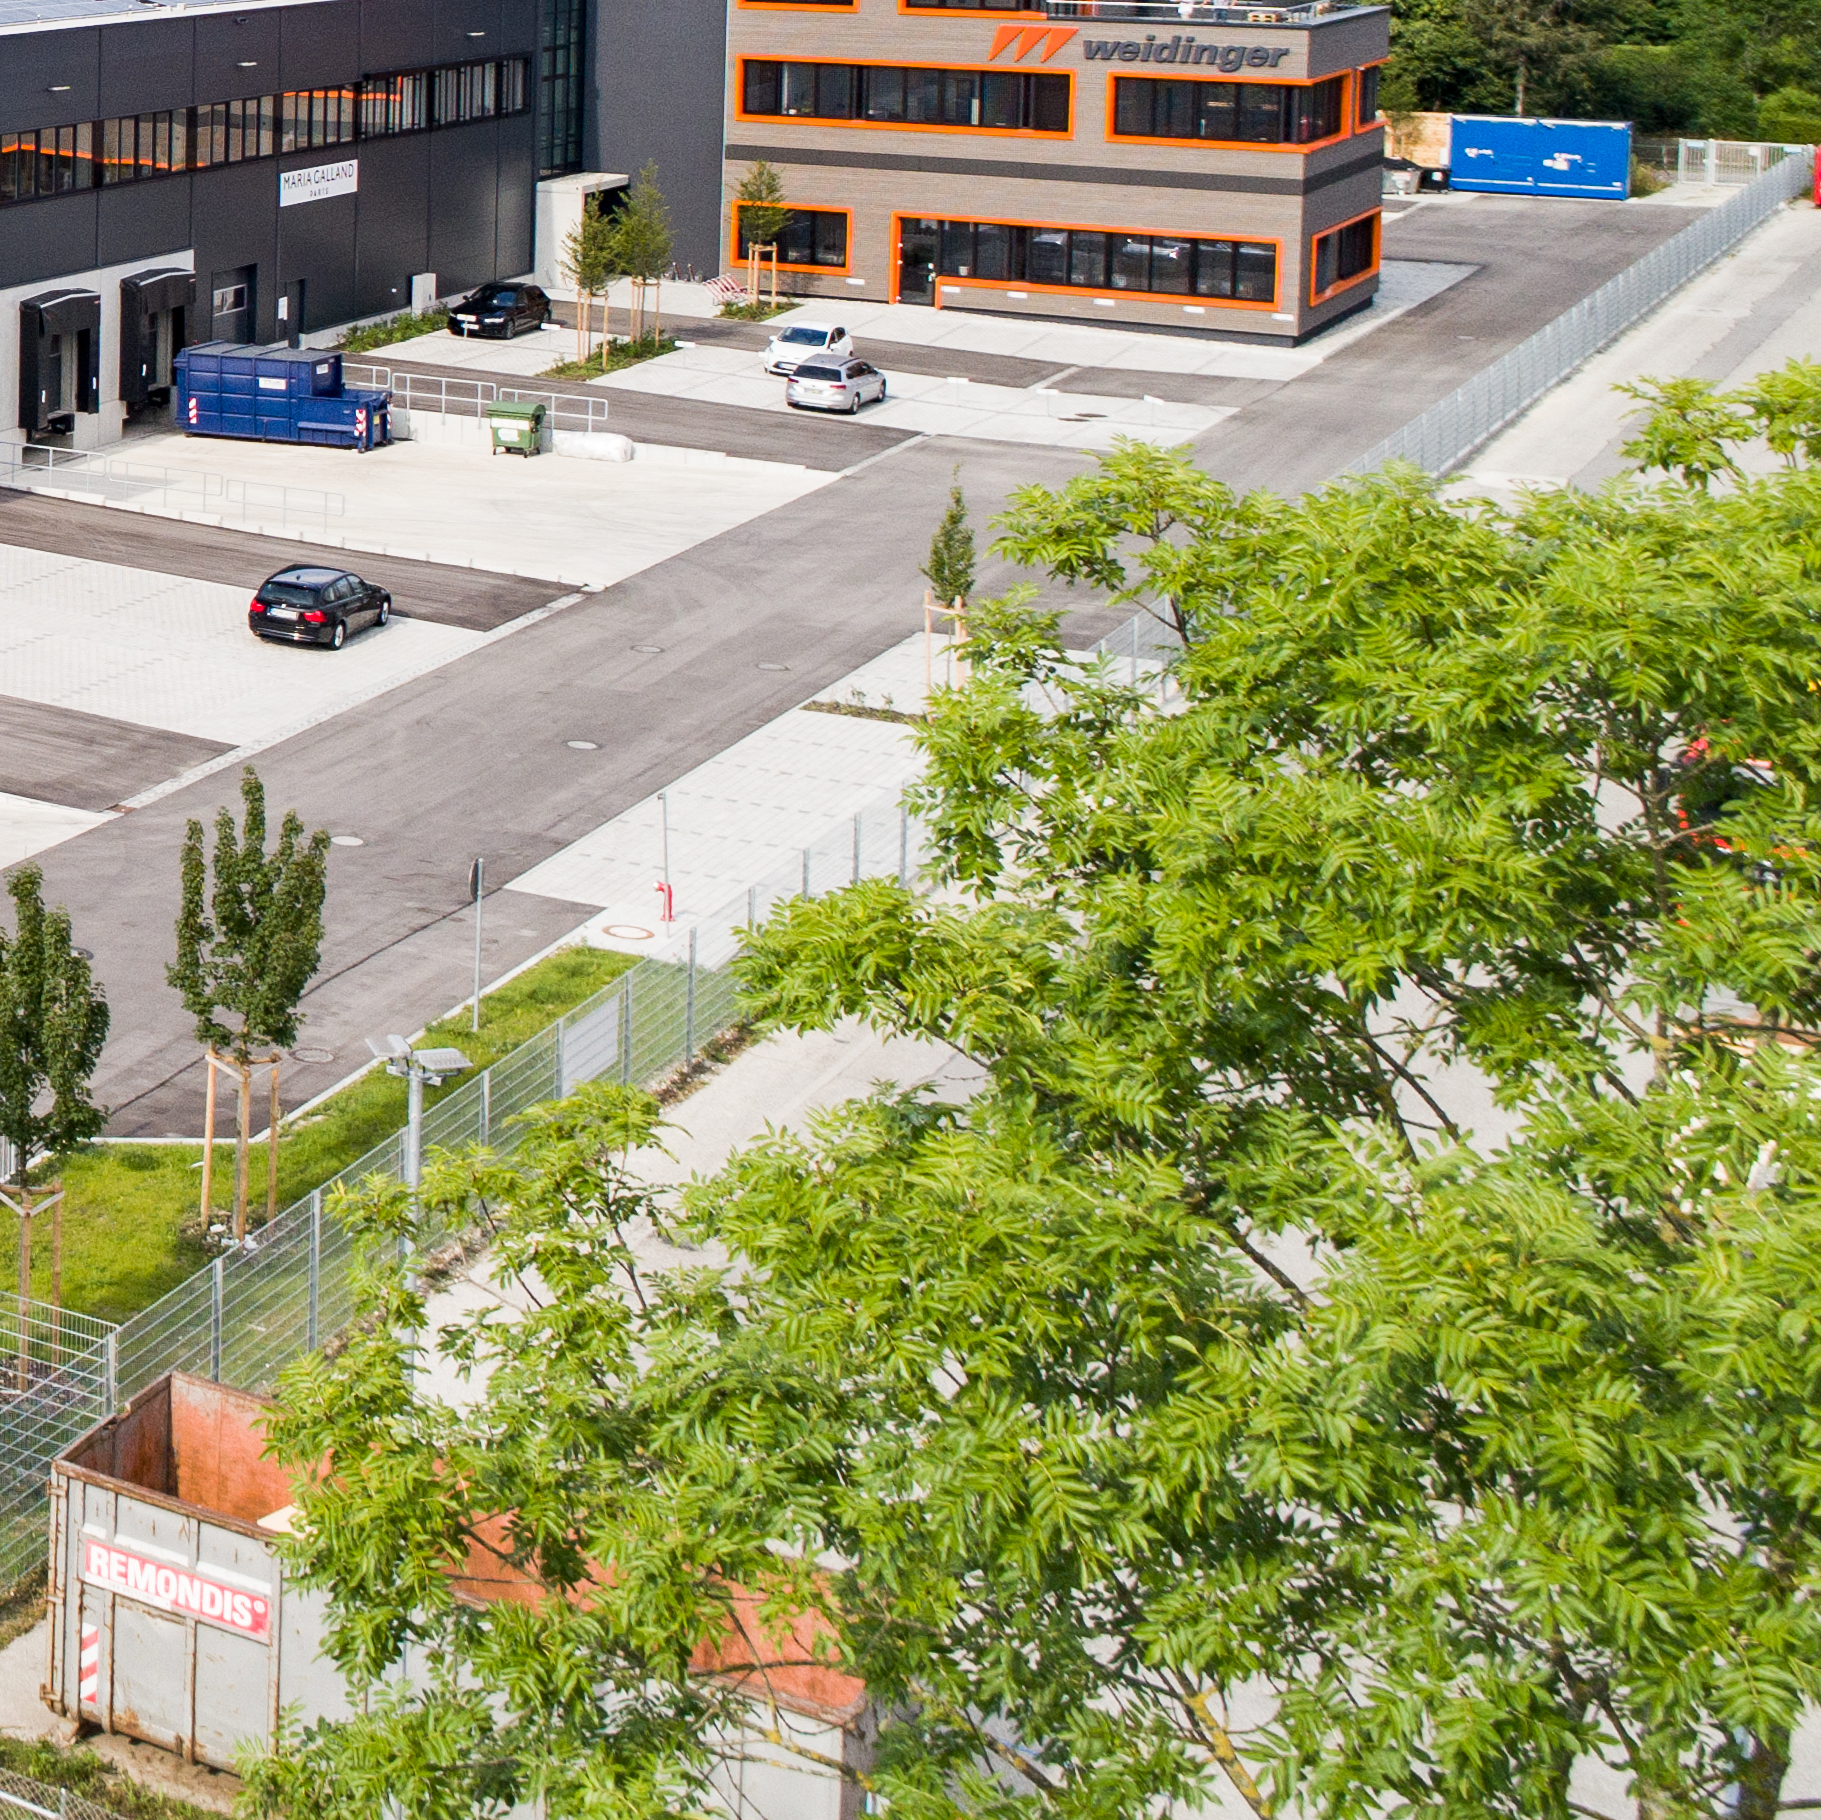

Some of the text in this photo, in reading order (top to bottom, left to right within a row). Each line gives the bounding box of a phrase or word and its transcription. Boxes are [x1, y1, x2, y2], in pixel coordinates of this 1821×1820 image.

[1082, 34, 1290, 73] weidinger
[283, 163, 354, 191] MARIA GALLAND
[90, 1545, 253, 1627] REMONDIS
